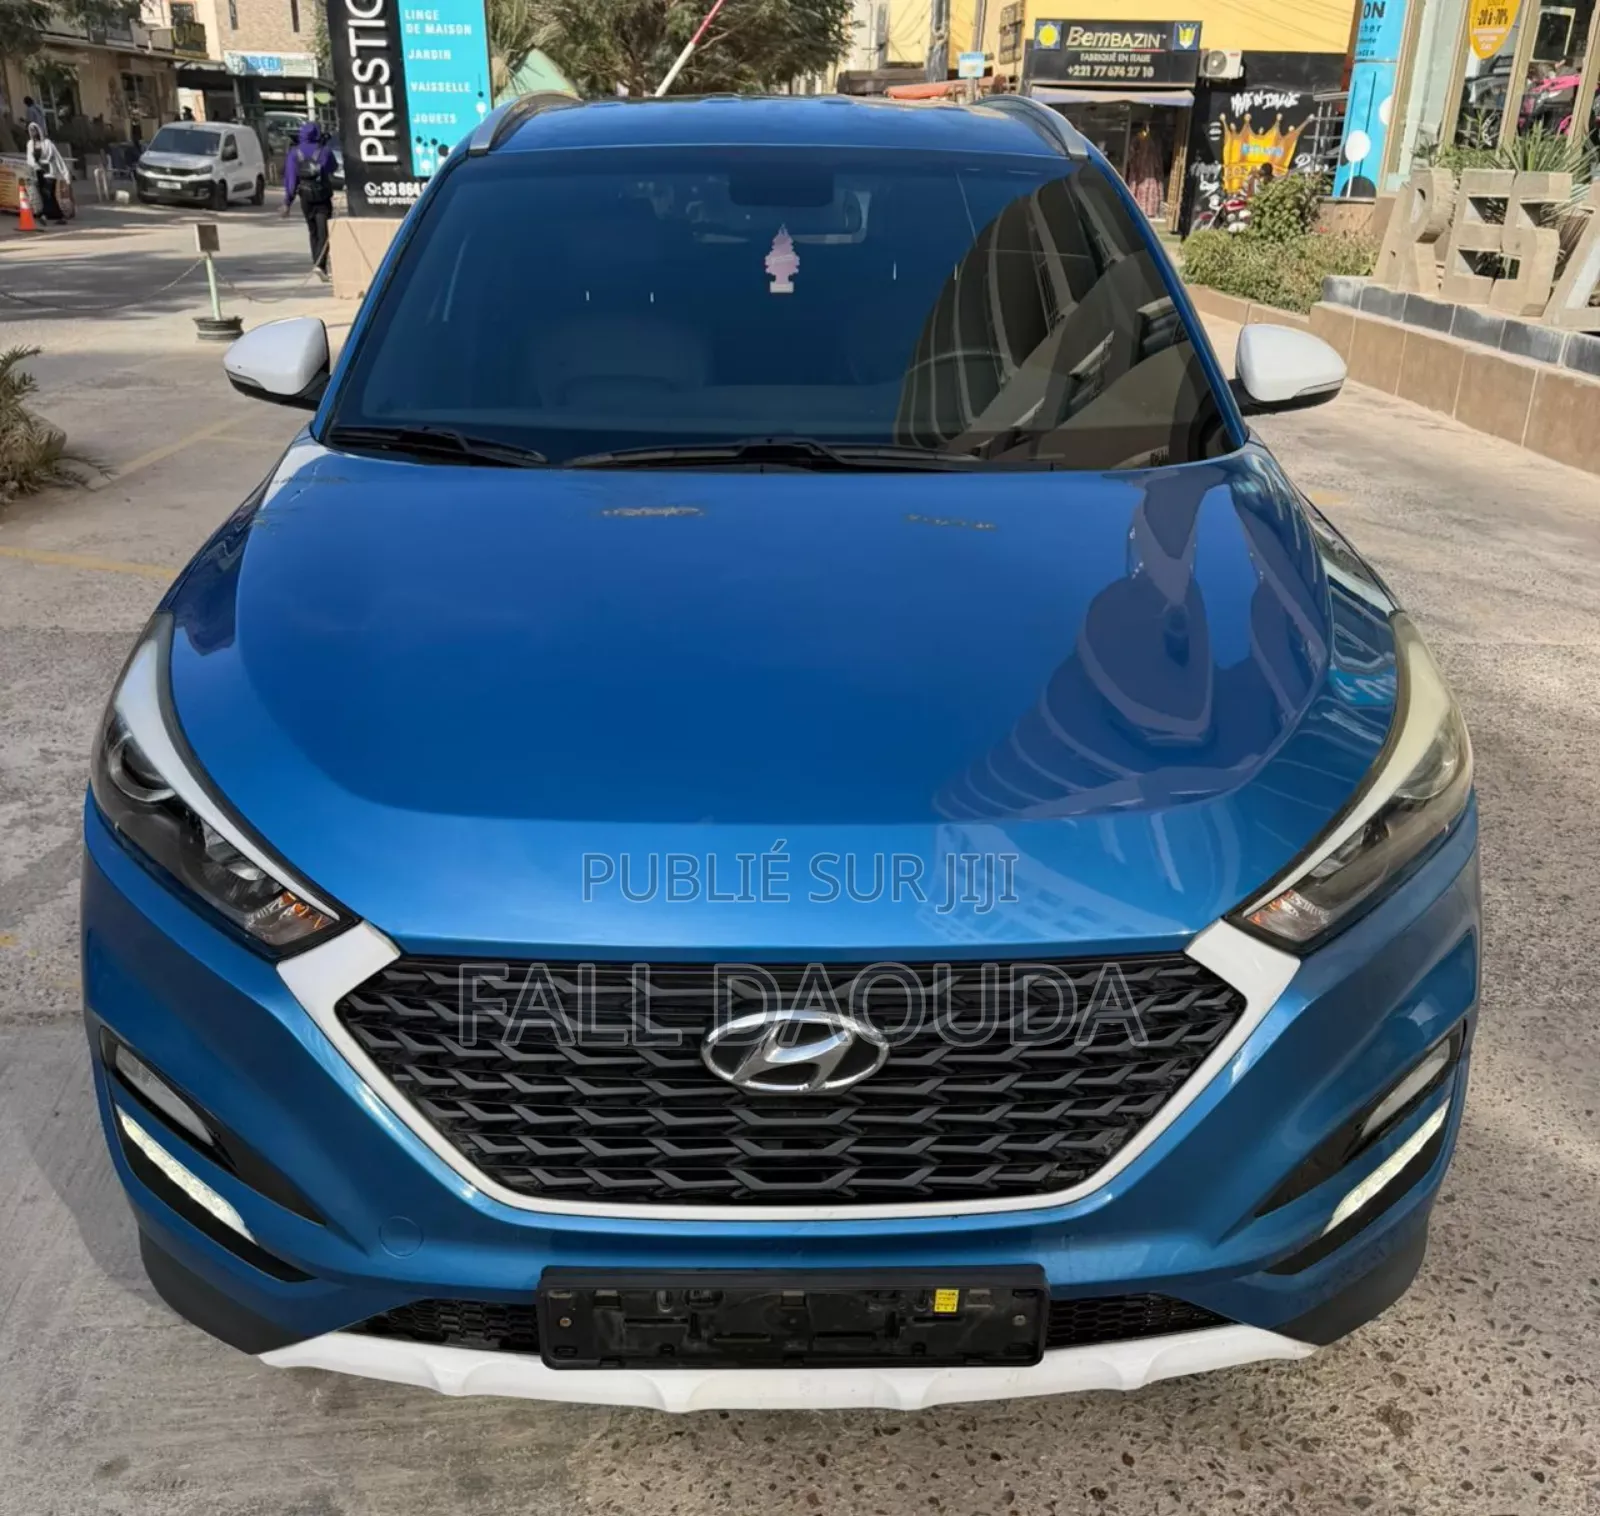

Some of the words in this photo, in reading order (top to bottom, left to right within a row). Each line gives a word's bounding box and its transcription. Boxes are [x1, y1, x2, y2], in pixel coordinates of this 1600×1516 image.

[404, 9, 440, 21] LINGE
[406, 23, 420, 35] DE
[424, 23, 472, 36] MAISON
[408, 49, 451, 60] JARDIN
[1118, 54, 1128, 62] EN
[1130, 54, 1151, 63] ITALIE
[1092, 65, 1107, 77] 77
[410, 80, 471, 93] VAISSELLE
[414, 112, 456, 124] JOUETS
